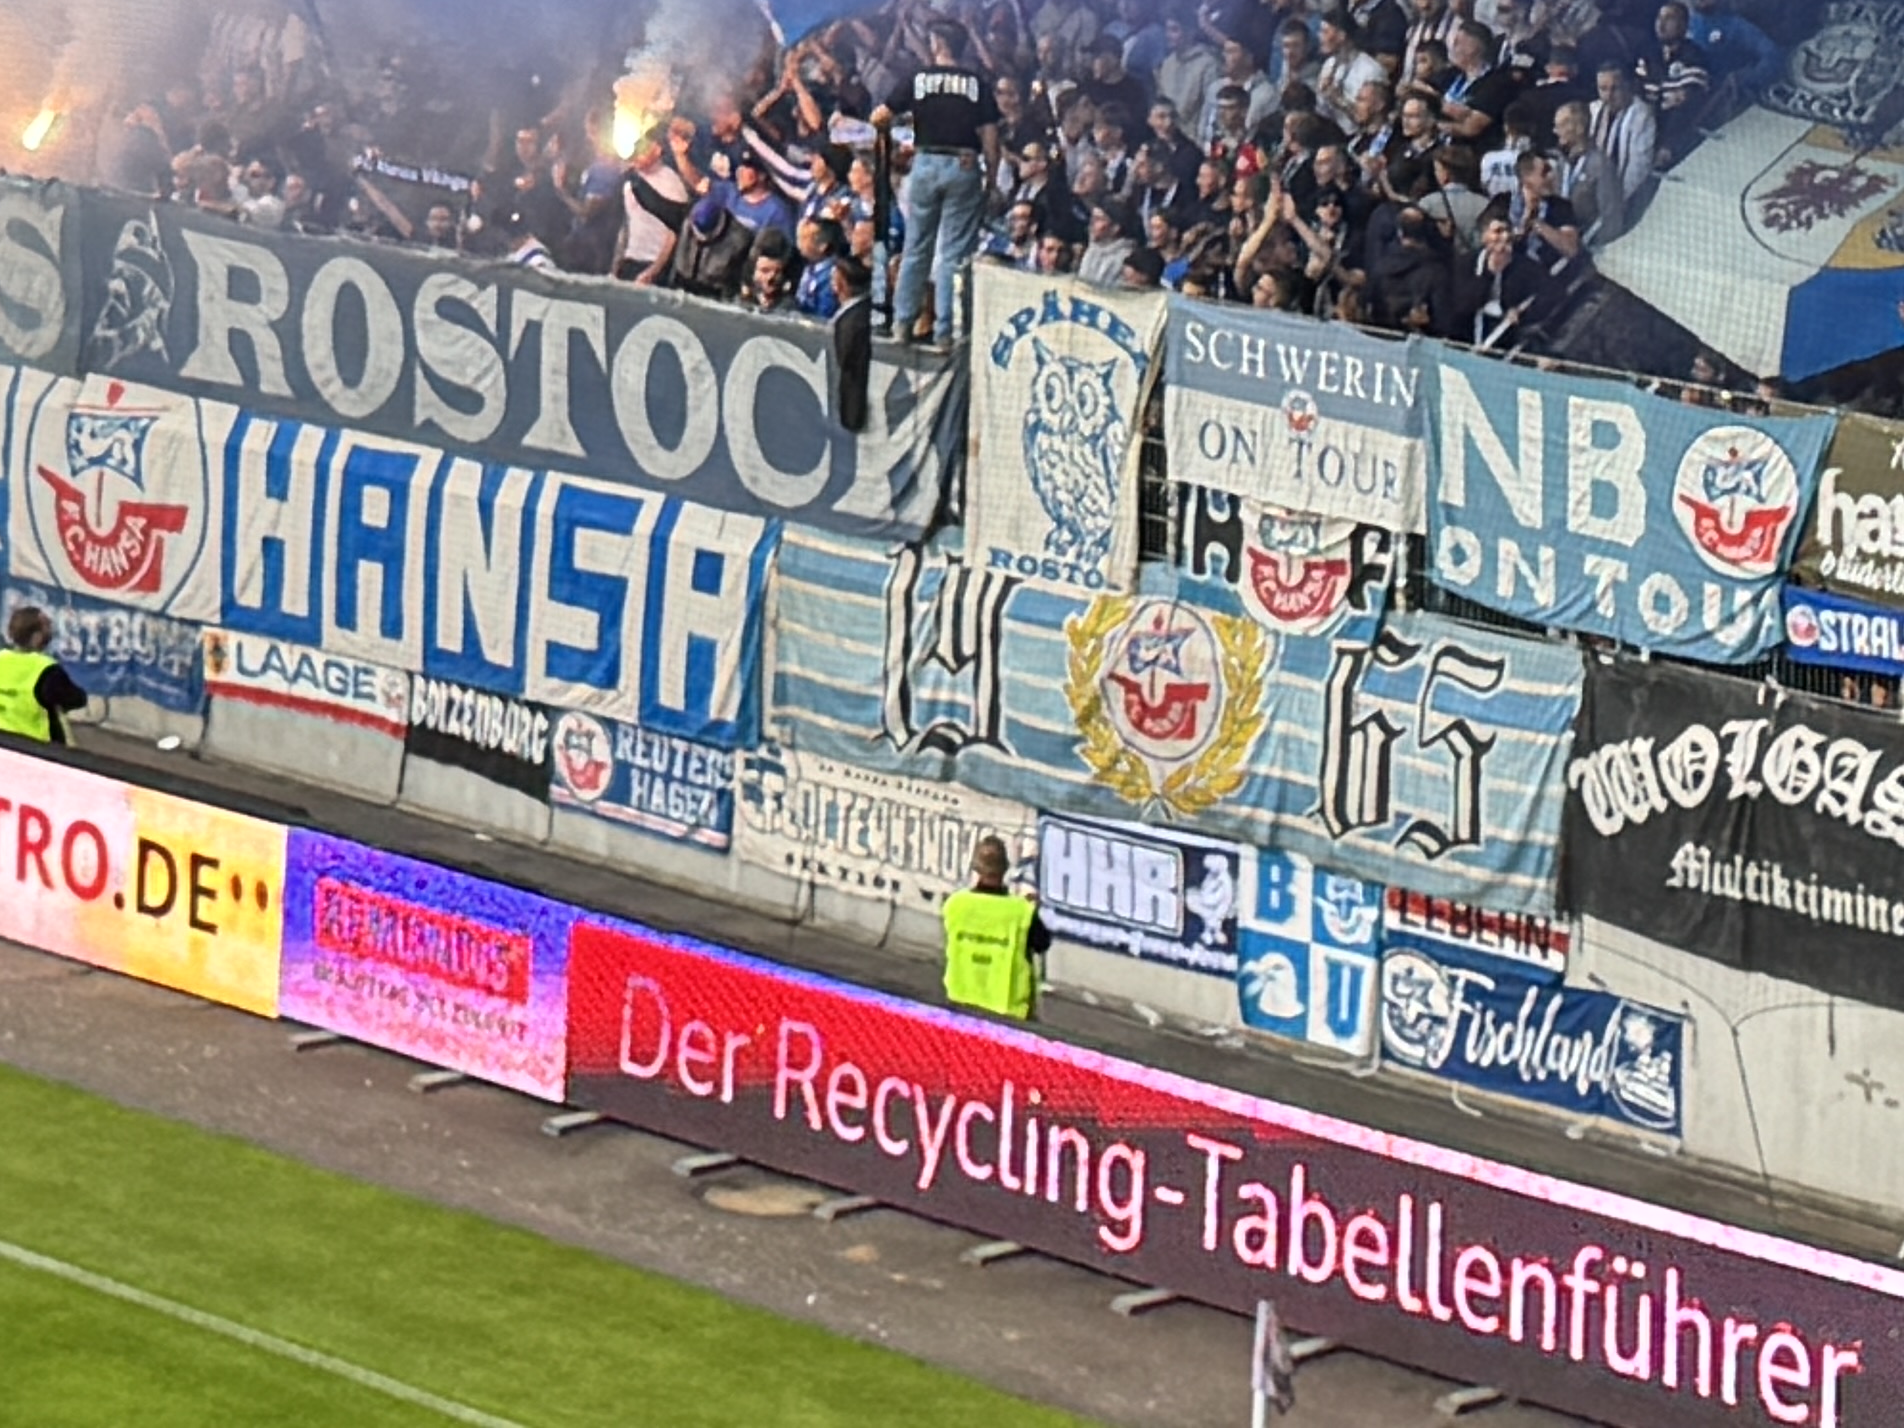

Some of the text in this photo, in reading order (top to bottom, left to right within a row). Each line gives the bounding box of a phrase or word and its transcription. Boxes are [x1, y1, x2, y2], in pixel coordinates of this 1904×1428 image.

[179, 228, 958, 520] ROSTOCK
[1183, 320, 1421, 409] SCHWERIN
[1199, 420, 1404, 503] ON TOUR
[1437, 362, 1647, 548] NB
[232, 412, 766, 724] HANSA
[987, 546, 1124, 591] ROSTO
[1436, 524, 1557, 609] ON
[234, 638, 378, 702] LAAGE
[412, 675, 549, 766] BOIZENBURG
[1425, 964, 1623, 1097] Fischland
[617, 975, 1863, 1428] Der Recycling-Tabellenführer
